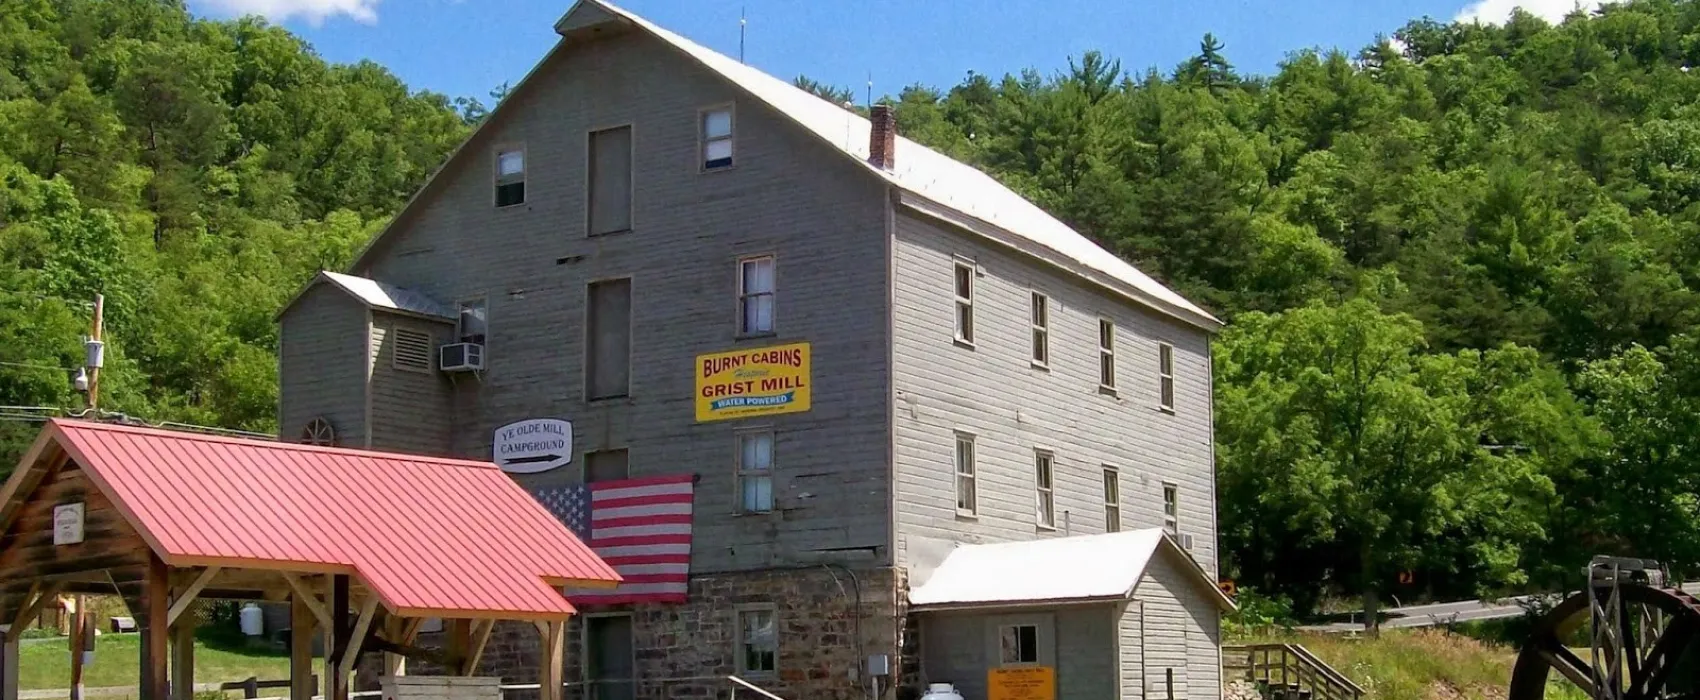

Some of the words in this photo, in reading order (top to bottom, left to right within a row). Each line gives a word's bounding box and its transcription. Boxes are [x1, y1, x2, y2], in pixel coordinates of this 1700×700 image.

[704, 354, 748, 378] BURNT
[751, 348, 802, 367] CABINS
[701, 381, 755, 398] GRIST
[761, 375, 805, 391] MILL
[718, 397, 745, 408] WATER
[746, 395, 788, 406] POWERED
[502, 428, 515, 441] YE
[516, 423, 541, 436] OLDE
[500, 439, 565, 454] CAMPGROUND
